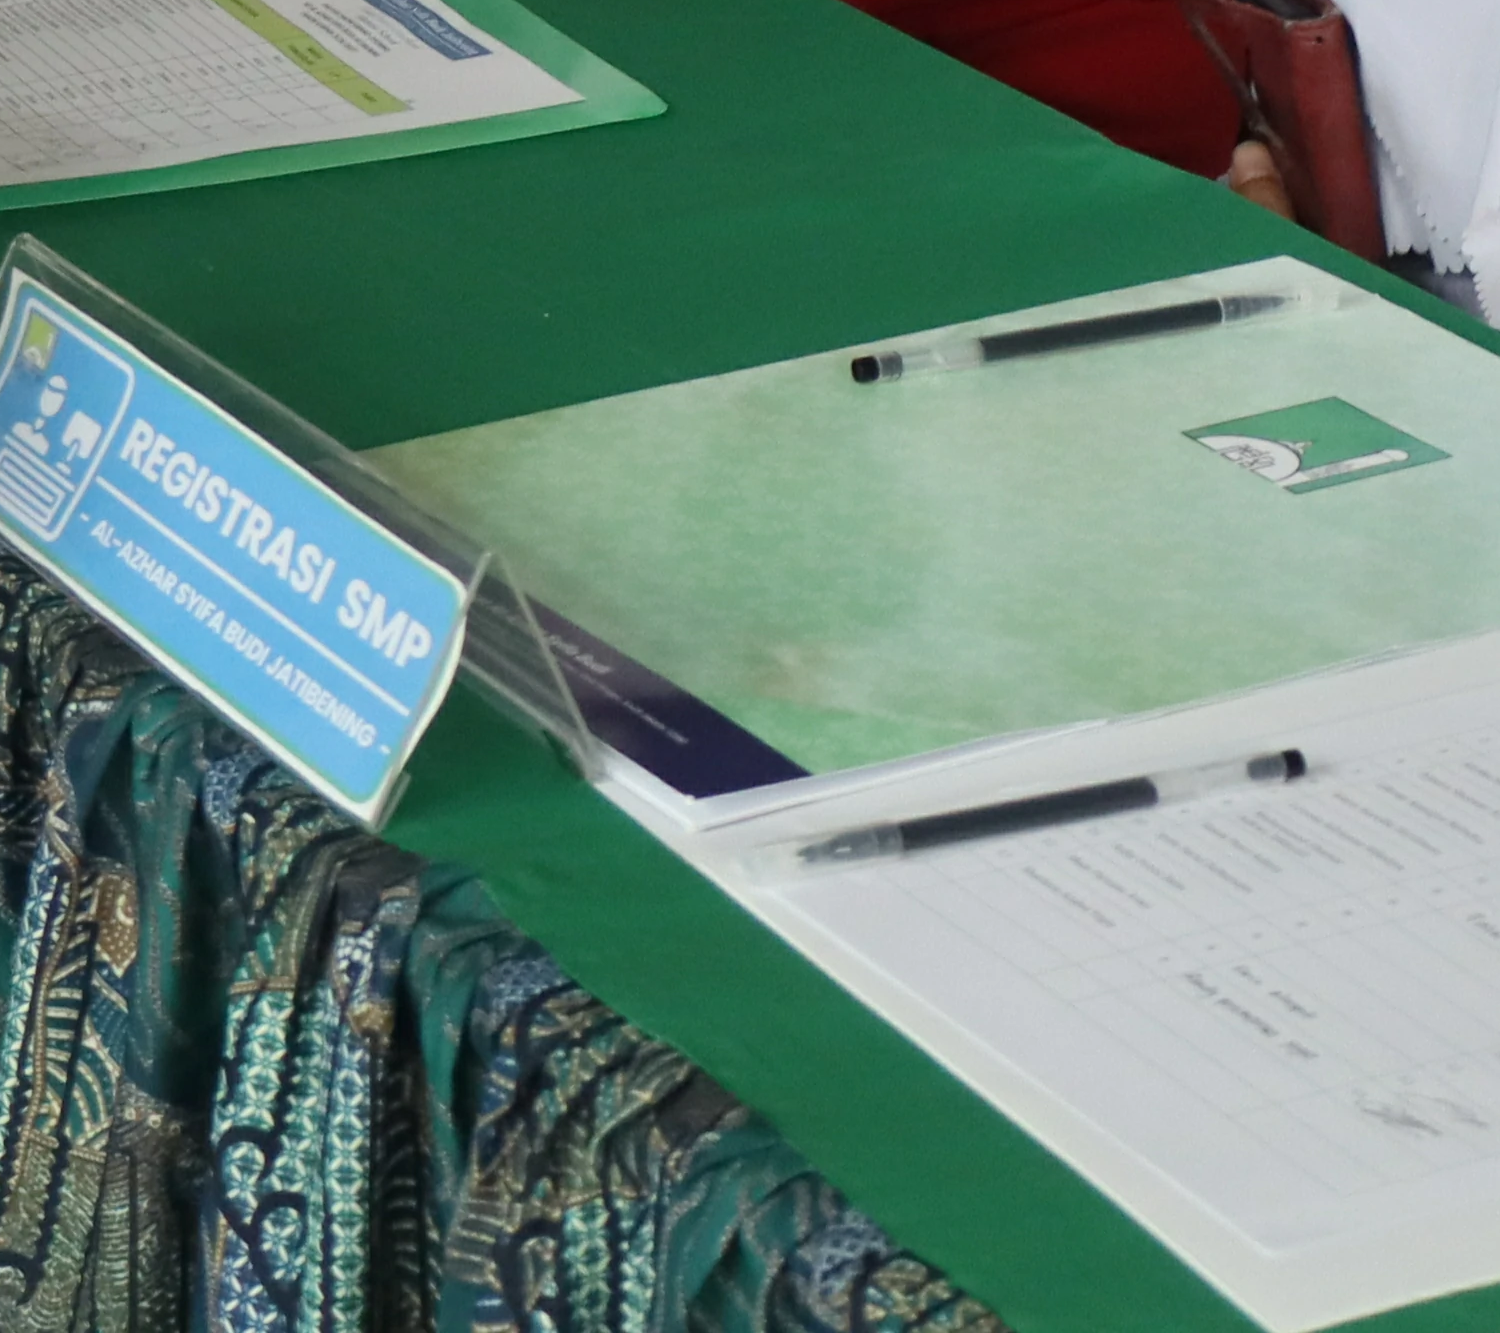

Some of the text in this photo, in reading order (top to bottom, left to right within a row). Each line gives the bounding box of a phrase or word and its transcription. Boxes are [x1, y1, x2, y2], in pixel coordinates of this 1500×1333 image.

[90, 518, 178, 596] AL-AZHAR
[173, 581, 225, 634] SYIFA
[221, 619, 272, 668] BUDI
[265, 655, 379, 748] JATIBENING
[120, 417, 433, 668] REGISTRASI SMP
